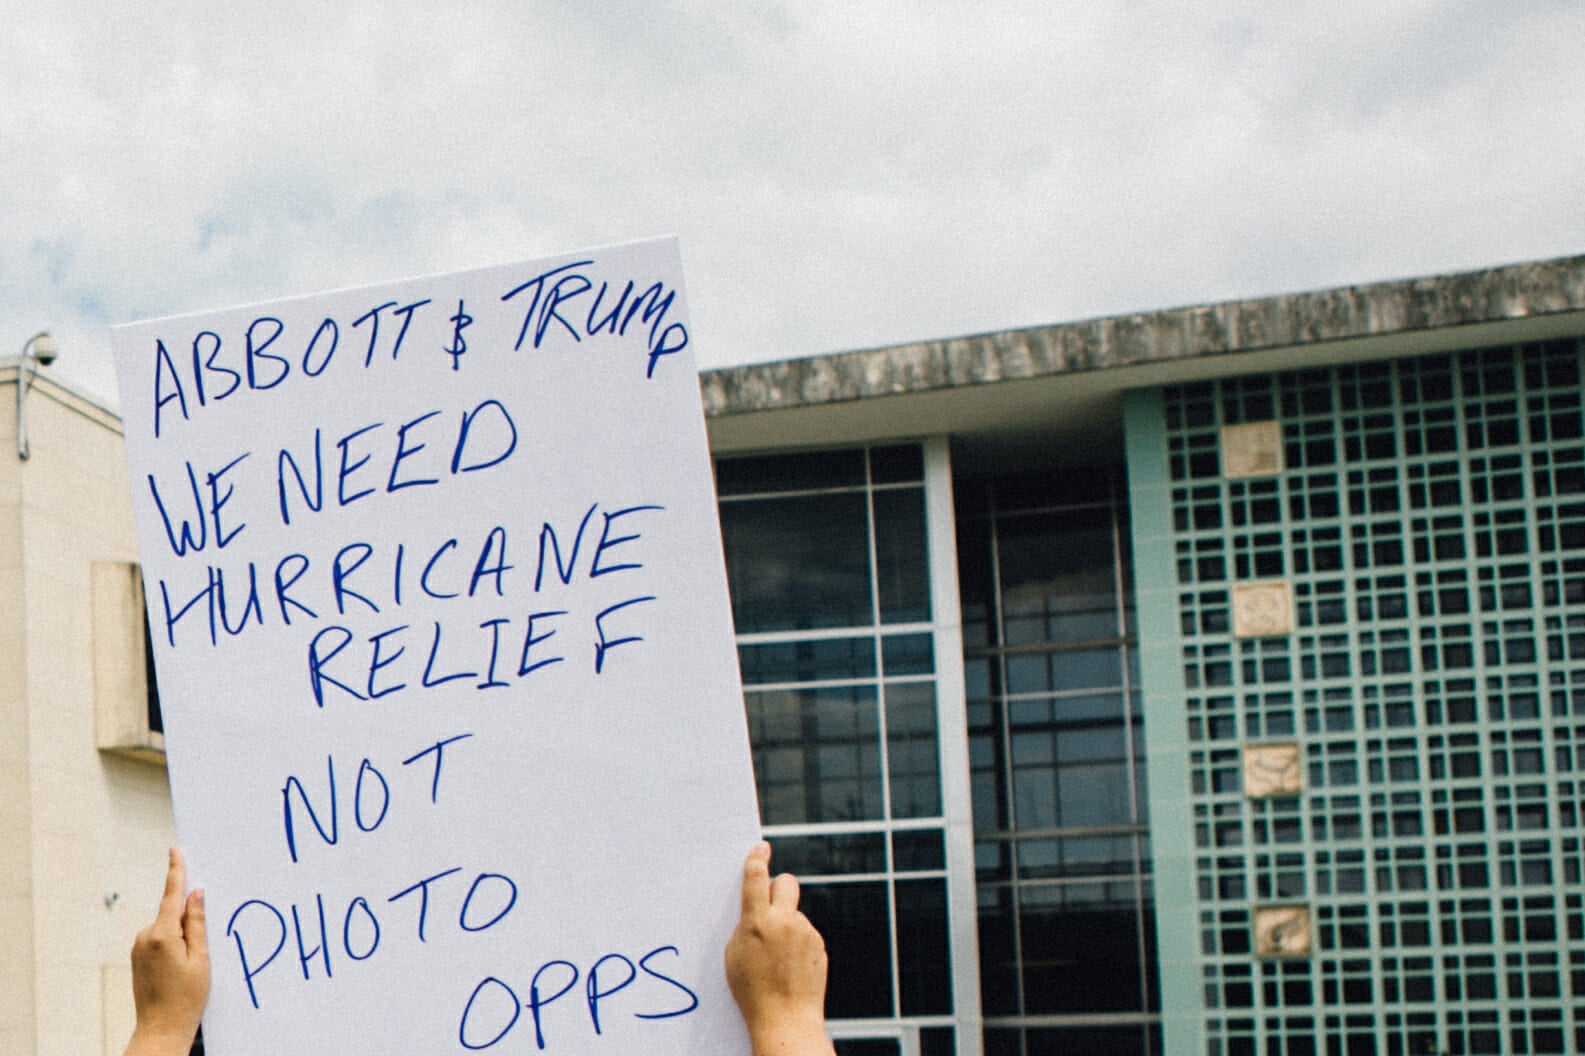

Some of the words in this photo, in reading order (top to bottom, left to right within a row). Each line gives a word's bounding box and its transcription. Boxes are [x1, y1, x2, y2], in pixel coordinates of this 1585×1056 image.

[154, 299, 433, 439] ABBOTT
[501, 260, 689, 379] TRUMP
[148, 452, 252, 557] WE
[277, 400, 518, 528] NEED
[159, 502, 666, 648] HURRICANE
[308, 596, 658, 708] RELIEF
[281, 733, 474, 863] NOT
[226, 866, 518, 1009] PHOTO
[459, 945, 699, 1050] OPPS
